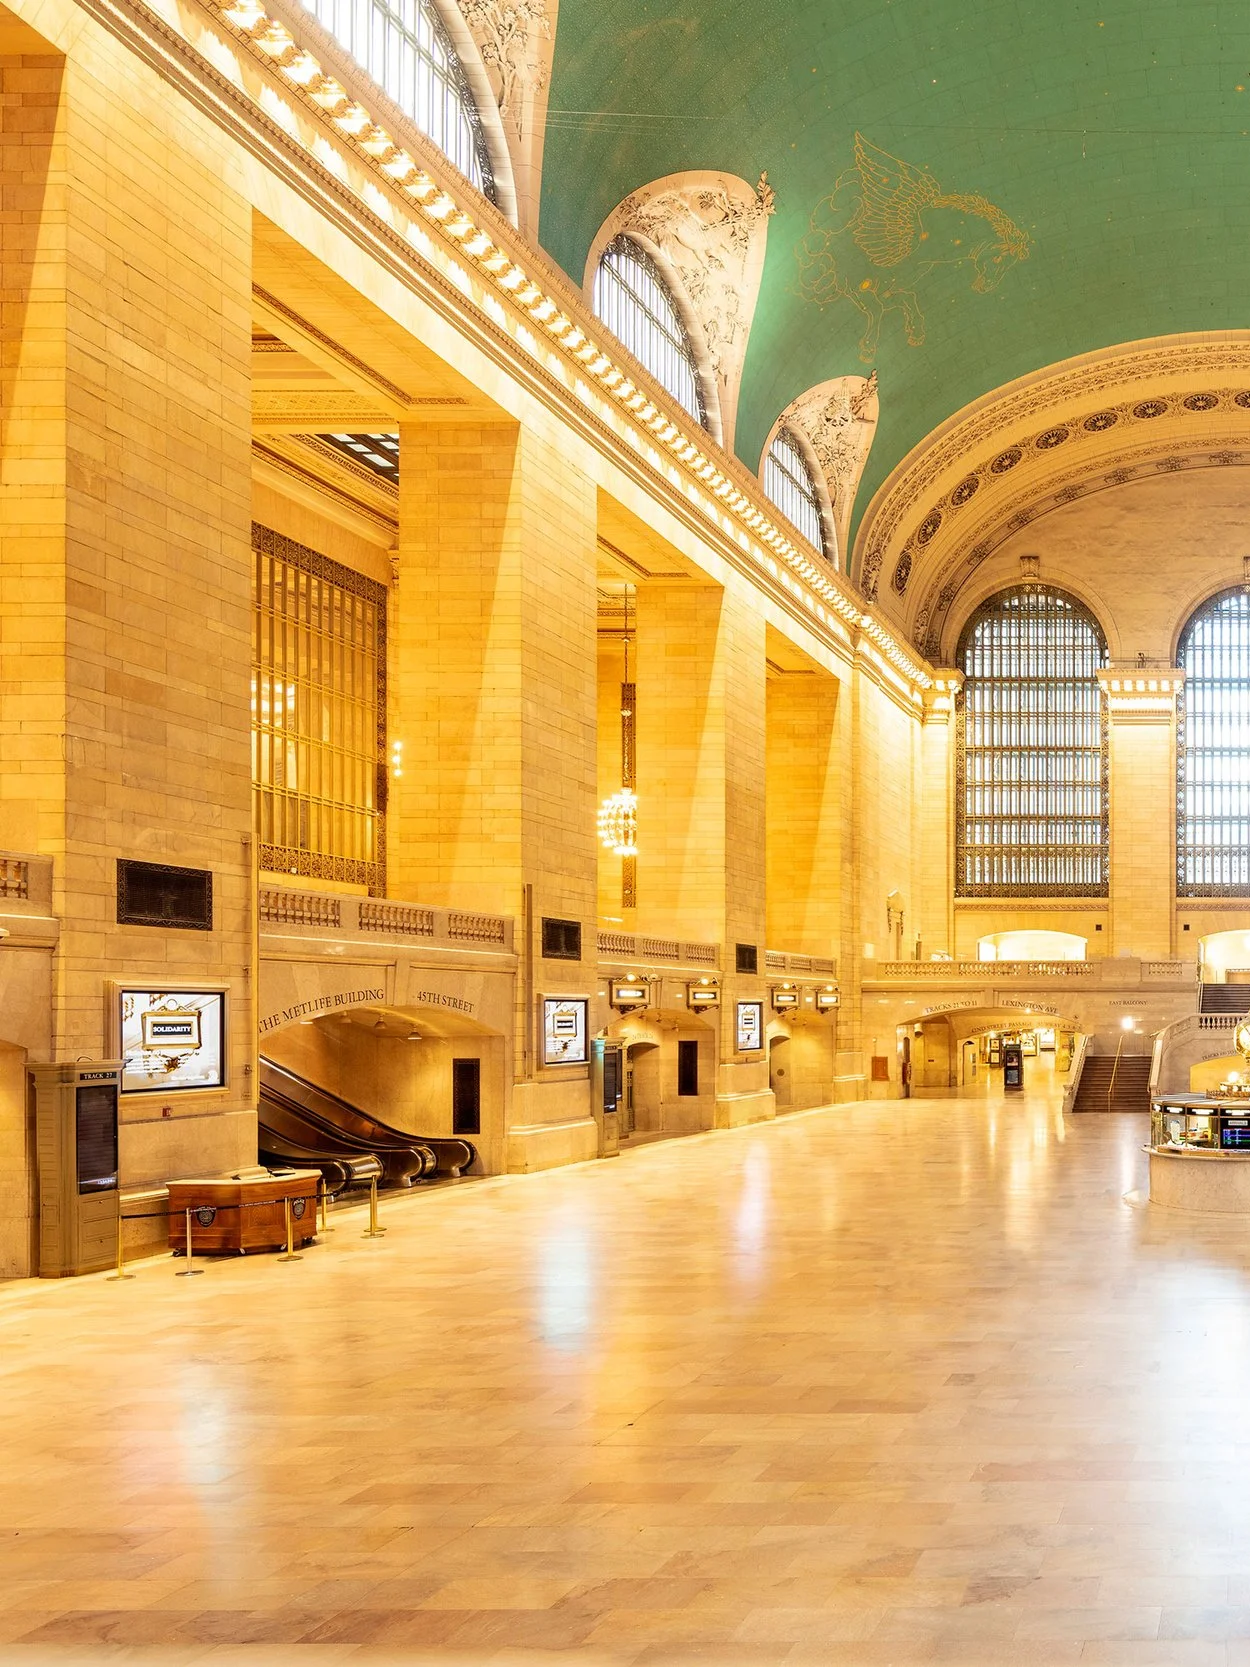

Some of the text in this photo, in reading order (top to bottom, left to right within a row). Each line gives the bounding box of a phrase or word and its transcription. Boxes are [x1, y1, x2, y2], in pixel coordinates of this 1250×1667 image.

[417, 991, 474, 1013] 45TH STREET
[925, 1004, 951, 1013] TRACKS
[1002, 1000, 1044, 1011] LEXINGTON
[258, 988, 384, 1033] THE METLIFE BUILDING
